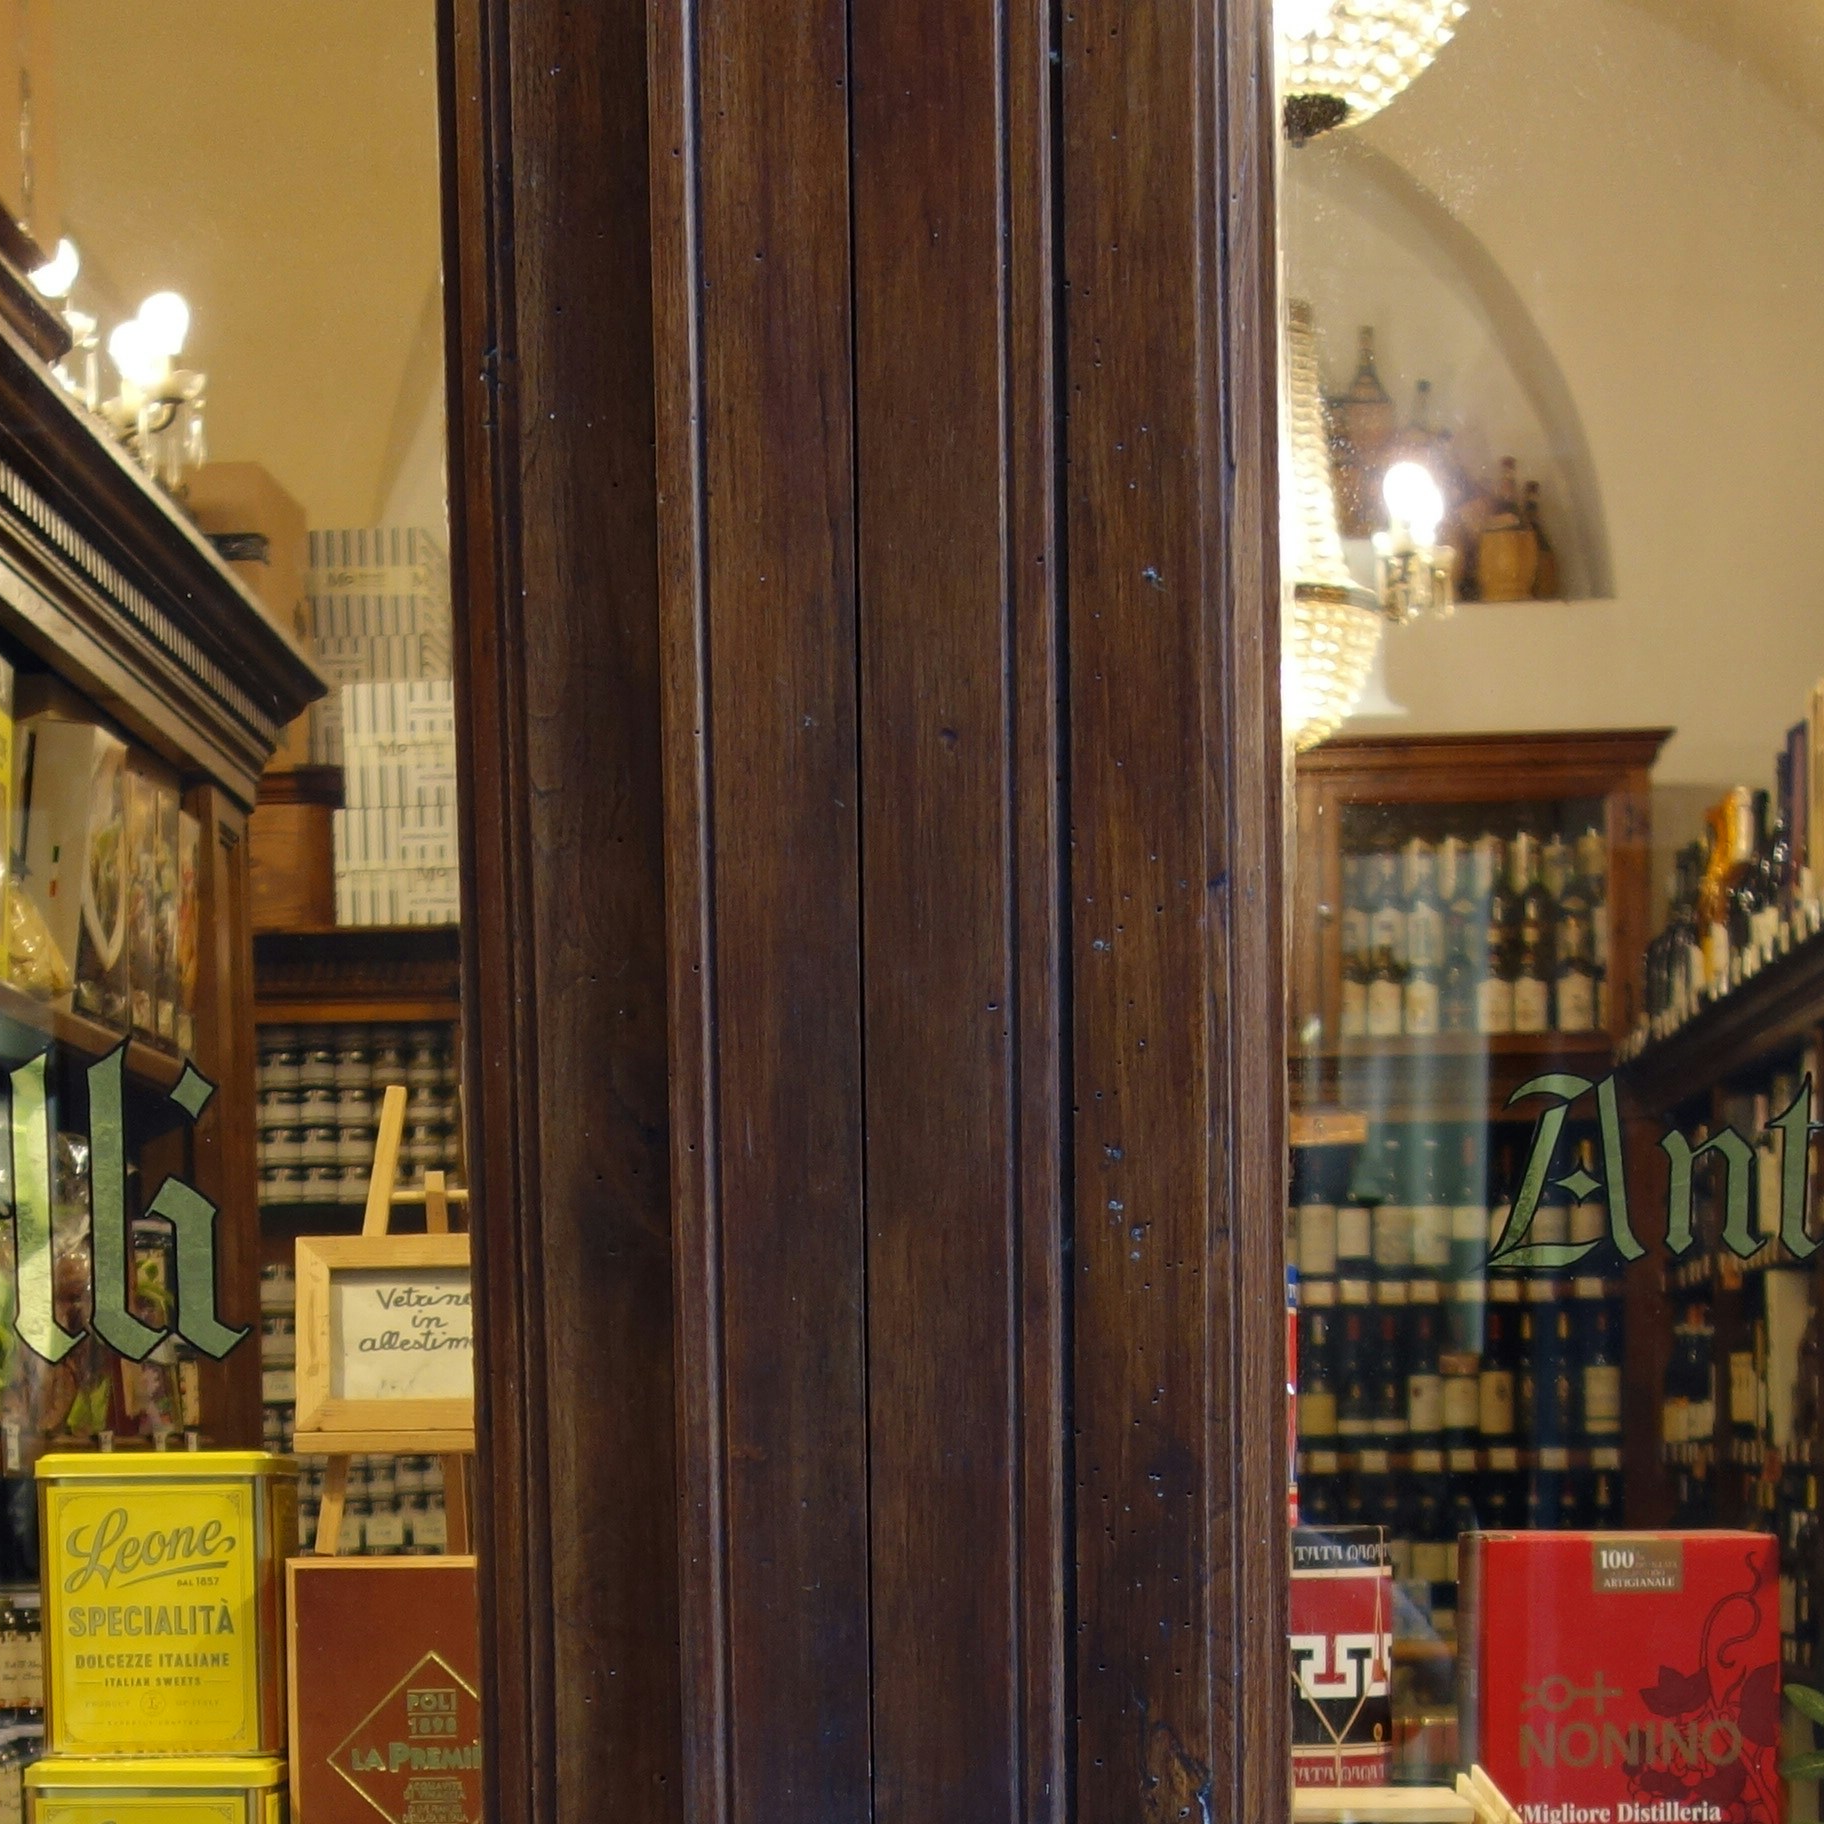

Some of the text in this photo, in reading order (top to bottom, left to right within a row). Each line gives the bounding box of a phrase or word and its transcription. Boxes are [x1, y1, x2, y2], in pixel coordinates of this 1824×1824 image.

[412, 1311, 449, 1330] in
[64, 1507, 236, 1594] Leone
[1600, 1550, 1635, 1570] 100
[177, 1577, 219, 1587] DAL 1857
[1603, 1575, 1675, 1589] ARTIGIANALE
[68, 1598, 234, 1637] SPECIALITÀ
[76, 1653, 230, 1669] DOLCEZZE ITALIANE
[105, 1676, 202, 1688] ITALIAN SWEETS
[407, 1694, 456, 1711] POLI
[1519, 1719, 1743, 1768] NONINO
[351, 1749, 386, 1771] LA
[1617, 1801, 1722, 1824] Distilleria
